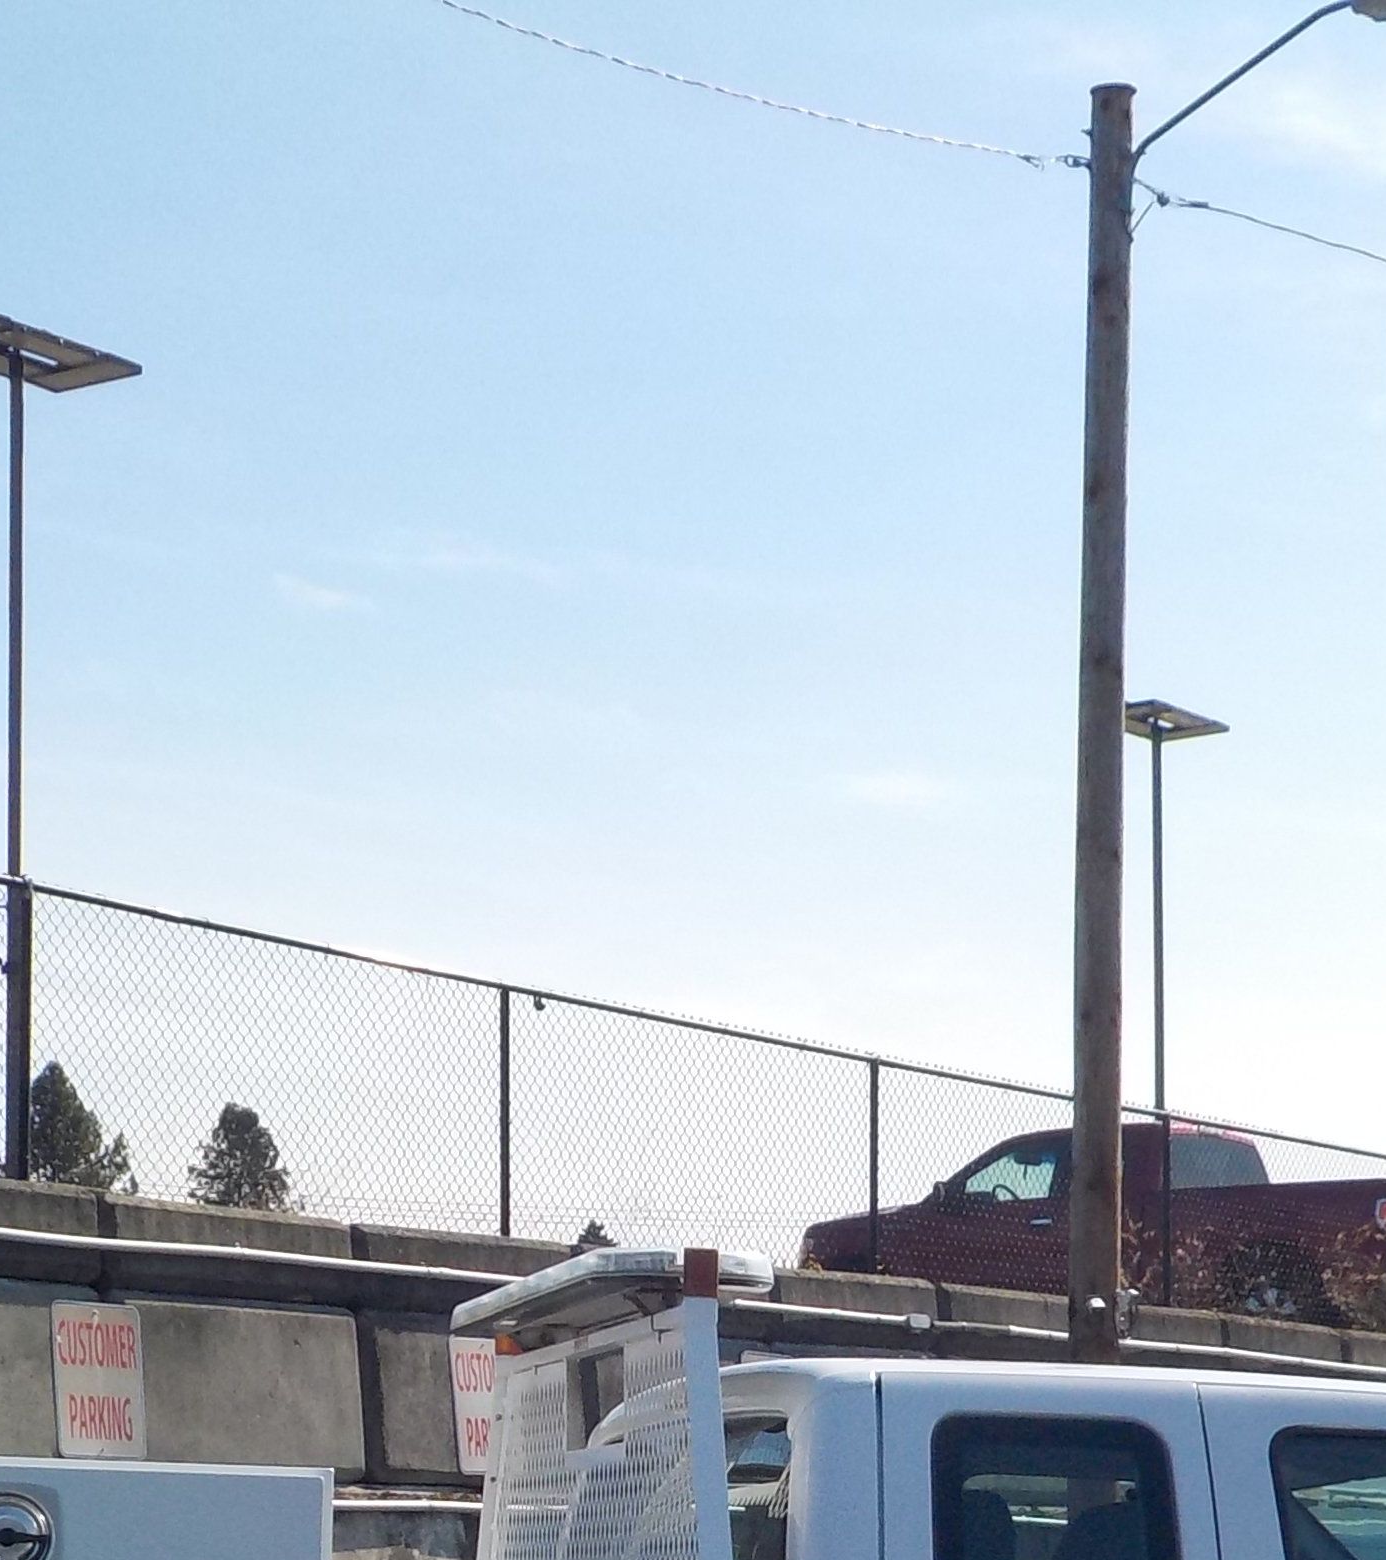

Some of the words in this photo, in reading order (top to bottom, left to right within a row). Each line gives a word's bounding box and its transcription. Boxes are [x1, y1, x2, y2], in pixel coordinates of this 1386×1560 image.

[57, 1319, 137, 1370] CUSTOMER
[454, 1352, 495, 1393] CUSTO
[68, 1393, 134, 1442] PARKING
